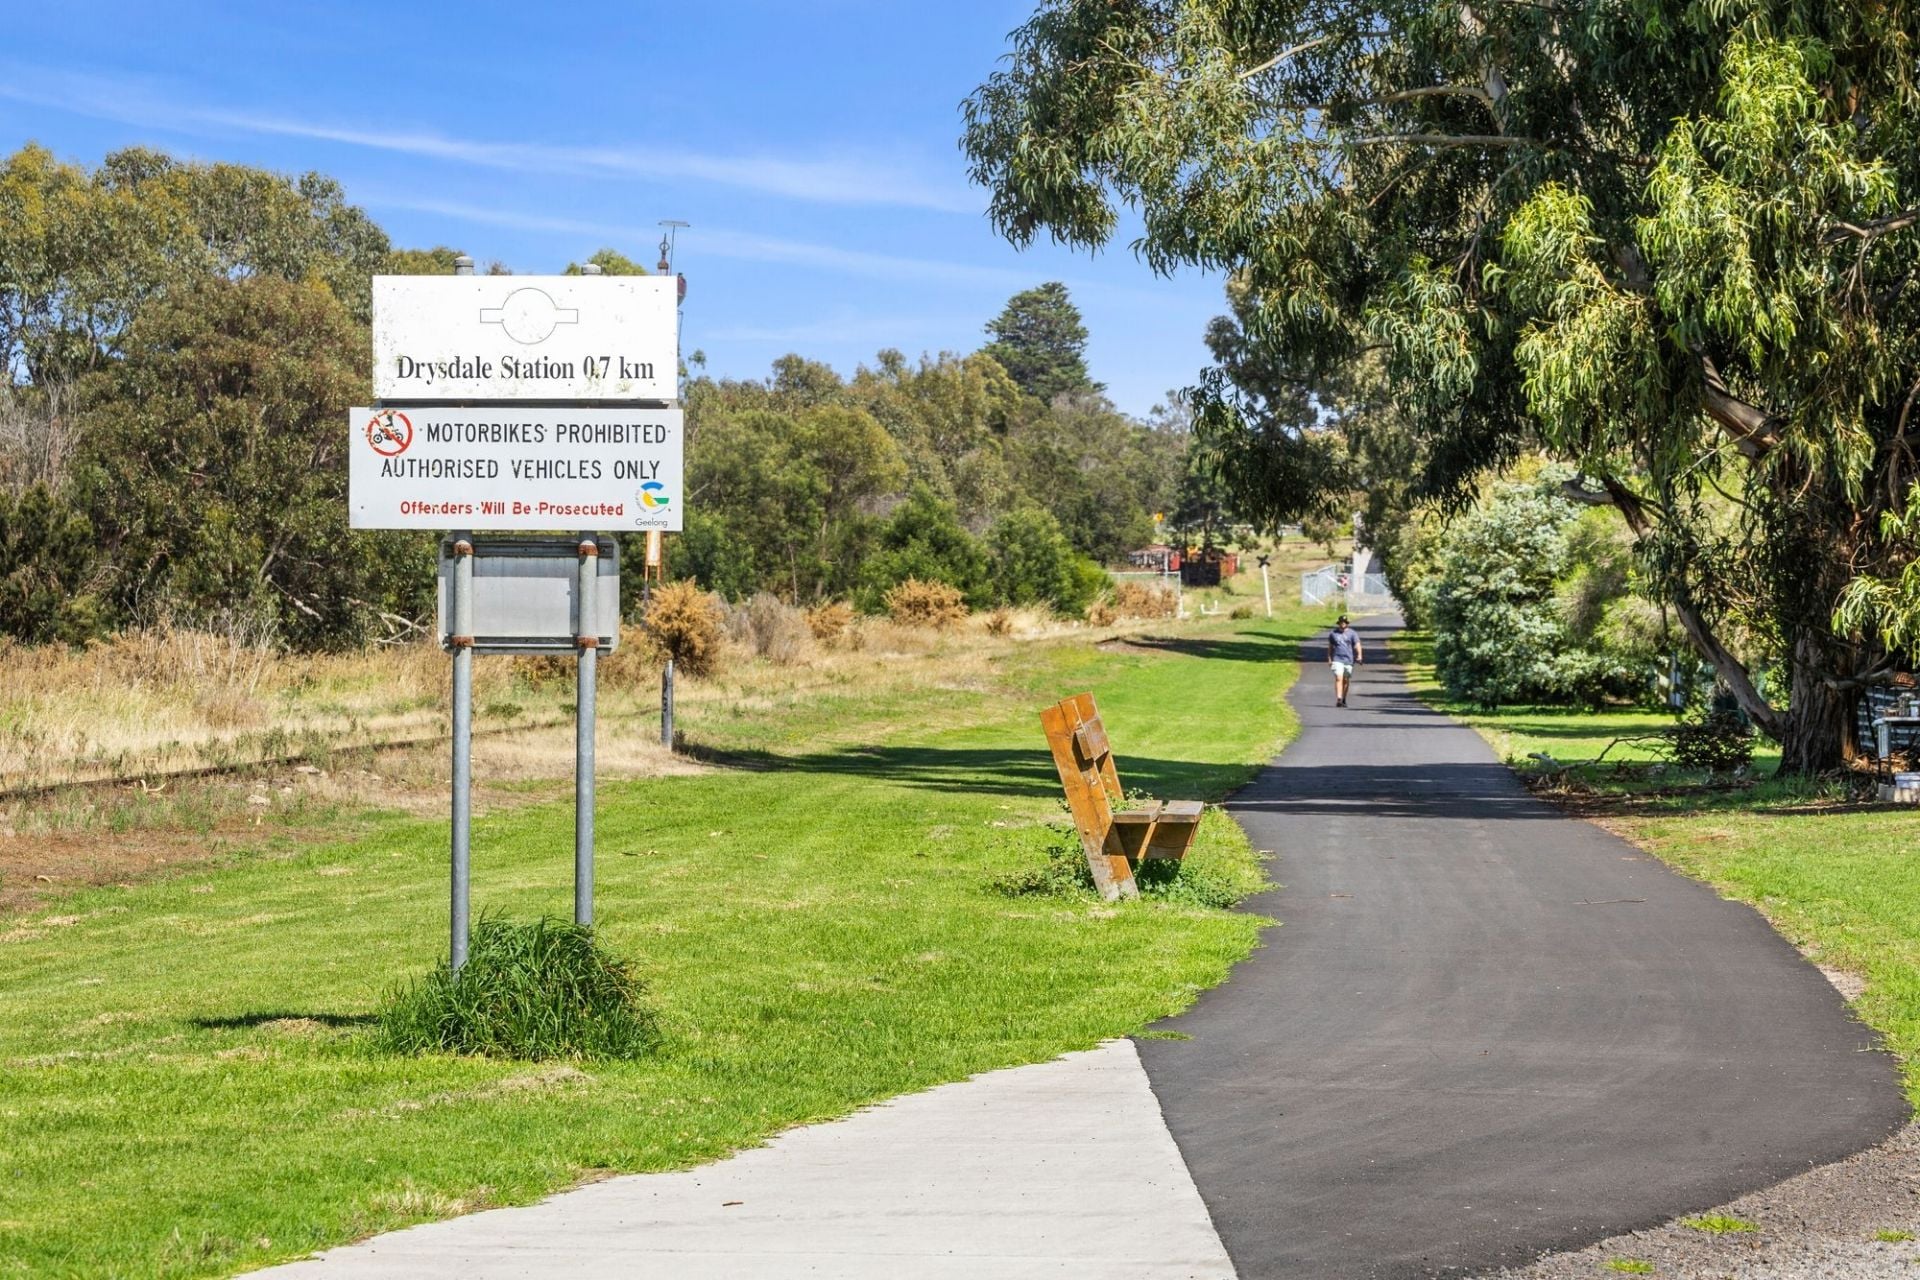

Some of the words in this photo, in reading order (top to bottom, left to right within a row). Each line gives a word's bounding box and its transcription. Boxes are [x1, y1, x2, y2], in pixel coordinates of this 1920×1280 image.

[396, 355, 493, 385] Drysdale
[500, 355, 575, 379] Station
[619, 355, 655, 379] km
[426, 423, 545, 443] MOTORBIKES
[556, 423, 666, 444] PROHIBITED
[380, 458, 499, 479] AUTHORISED
[511, 459, 602, 480] VEHICLES
[613, 460, 661, 480] ONLY
[400, 501, 473, 515] Offenders
[480, 501, 505, 515] Will
[512, 501, 531, 515] Be
[538, 502, 624, 516] Prosecuted
[634, 517, 668, 528] Geelong
